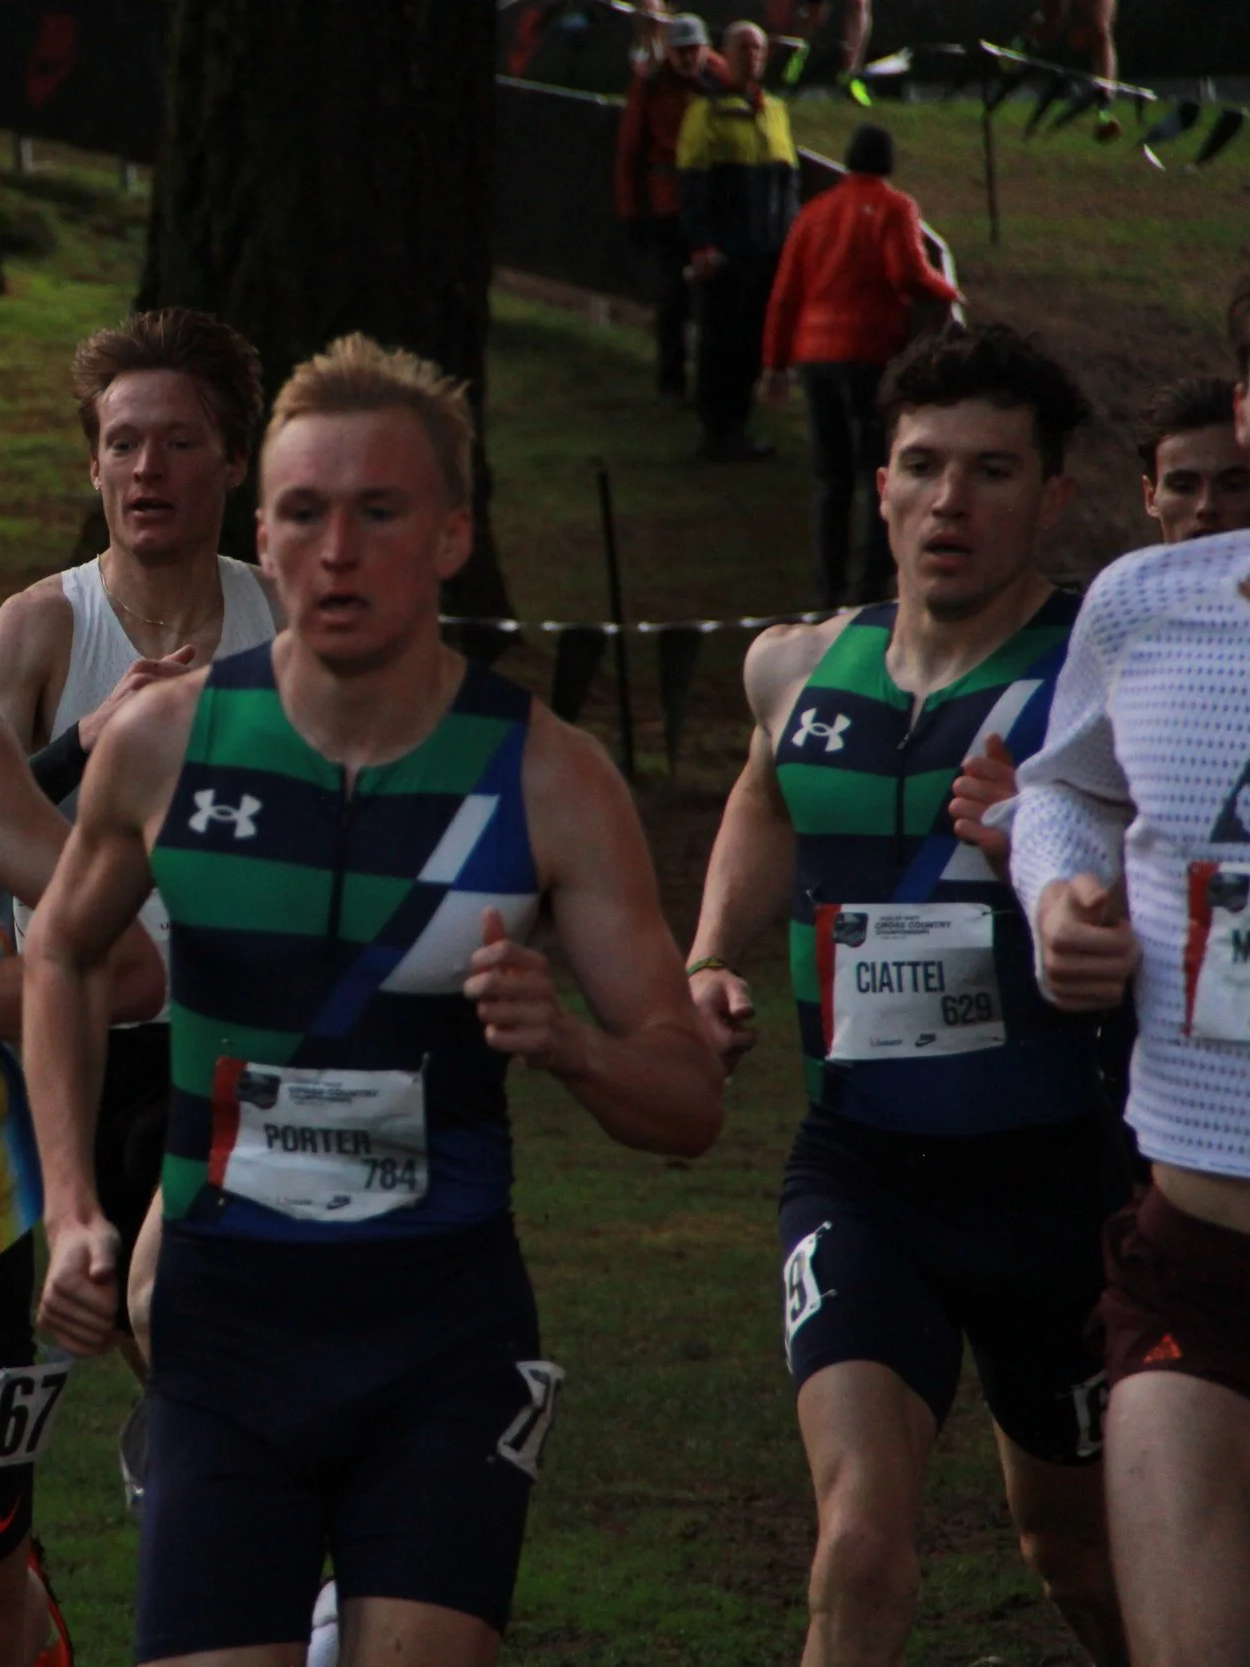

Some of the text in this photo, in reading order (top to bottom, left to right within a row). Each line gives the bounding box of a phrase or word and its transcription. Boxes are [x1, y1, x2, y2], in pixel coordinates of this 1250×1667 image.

[855, 960, 946, 994] CIATTEI
[941, 992, 993, 1026] 629
[263, 1123, 372, 1155] PORTER
[362, 1157, 418, 1191] 784
